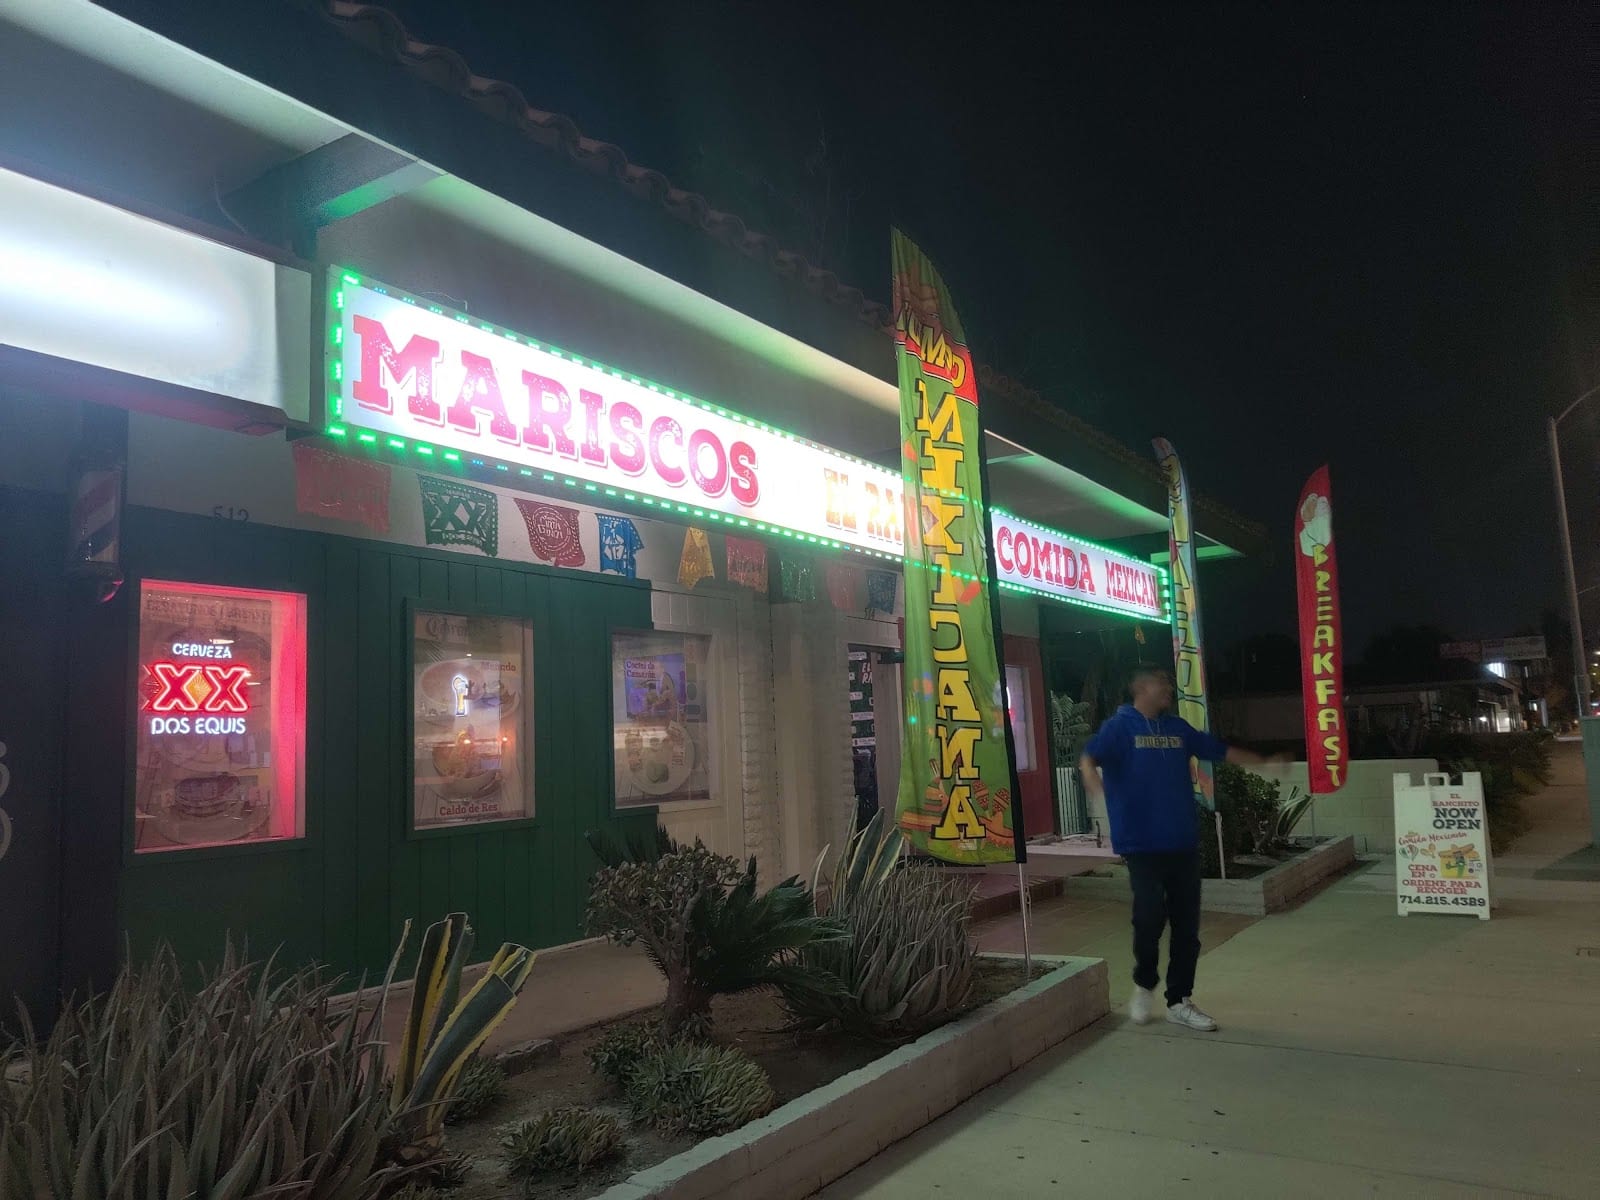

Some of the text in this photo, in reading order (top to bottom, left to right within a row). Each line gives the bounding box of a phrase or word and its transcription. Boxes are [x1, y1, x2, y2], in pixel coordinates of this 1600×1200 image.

[353, 314, 760, 506] MARISCOS
[996, 526, 1096, 596] COMIDA
[172, 642, 232, 659] CERVEZA
[152, 663, 250, 712] XX
[151, 716, 247, 736] DOS EQUIS
[439, 802, 499, 816] Caldo de Res
[1434, 808, 1478, 818] NOW
[1433, 819, 1481, 829] OPEN
[1408, 863, 1438, 872] CENA
[1402, 879, 1482, 889] ORDENE PARA
[1416, 886, 1468, 895] RECOGER
[1399, 895, 1486, 907] 714.215.4389
